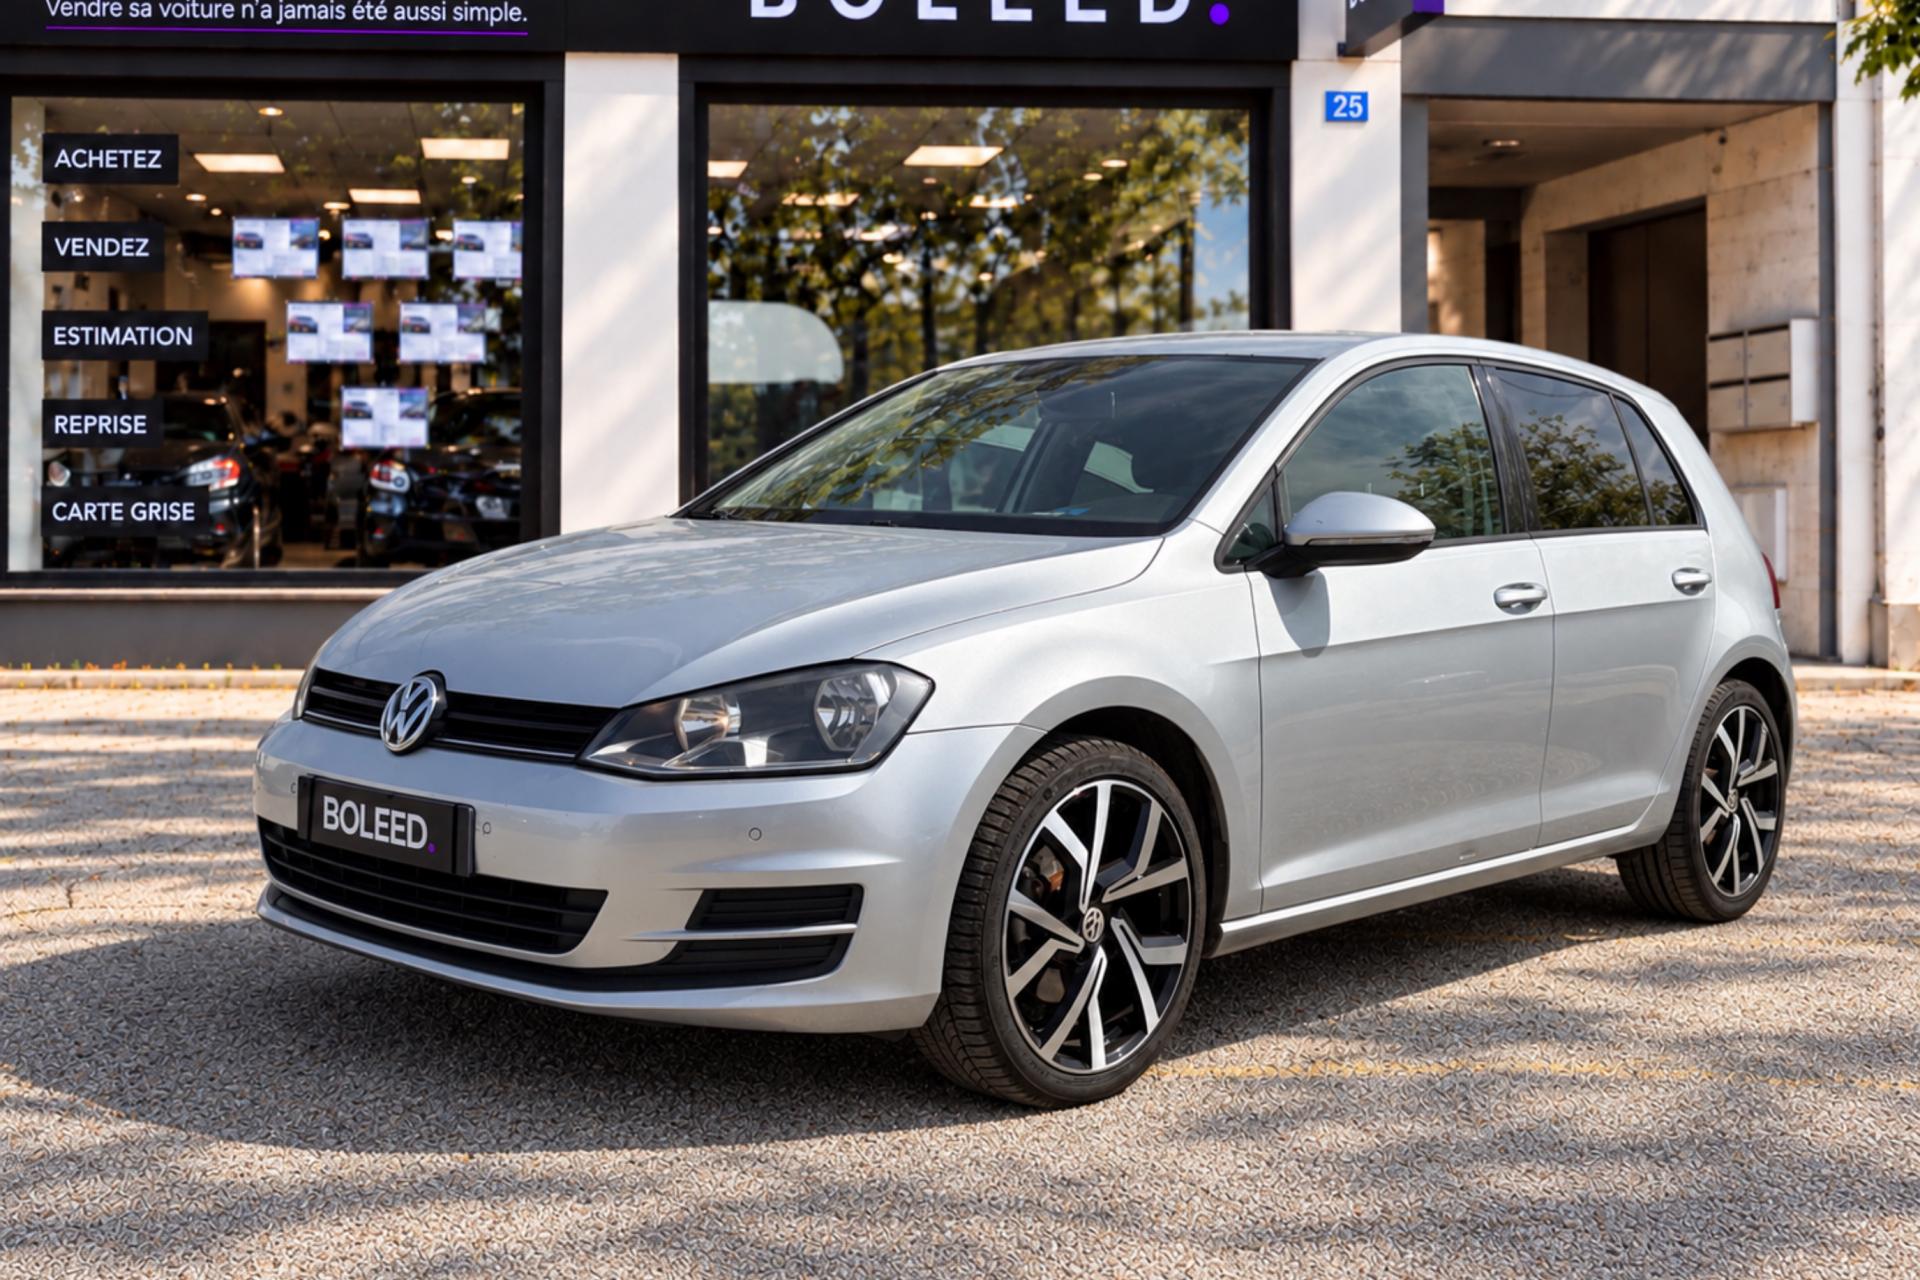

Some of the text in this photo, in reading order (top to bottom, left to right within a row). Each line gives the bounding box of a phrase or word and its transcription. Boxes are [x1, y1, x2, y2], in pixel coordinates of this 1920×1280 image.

[46, 0, 123, 18] Vendre
[128, 2, 152, 18] sa
[158, 0, 235, 19] voiture
[276, 0, 346, 25] jamais
[352, 0, 388, 21] été
[393, 1, 447, 22] aussi
[452, 1, 528, 27] simple.
[1333, 94, 1363, 118] 25
[54, 148, 162, 169] ACHETEZ
[54, 237, 150, 257] VENDEZ
[53, 326, 193, 346] ESTIMATION
[54, 415, 147, 435] REPRISE
[52, 502, 195, 522] CARTE GRISE
